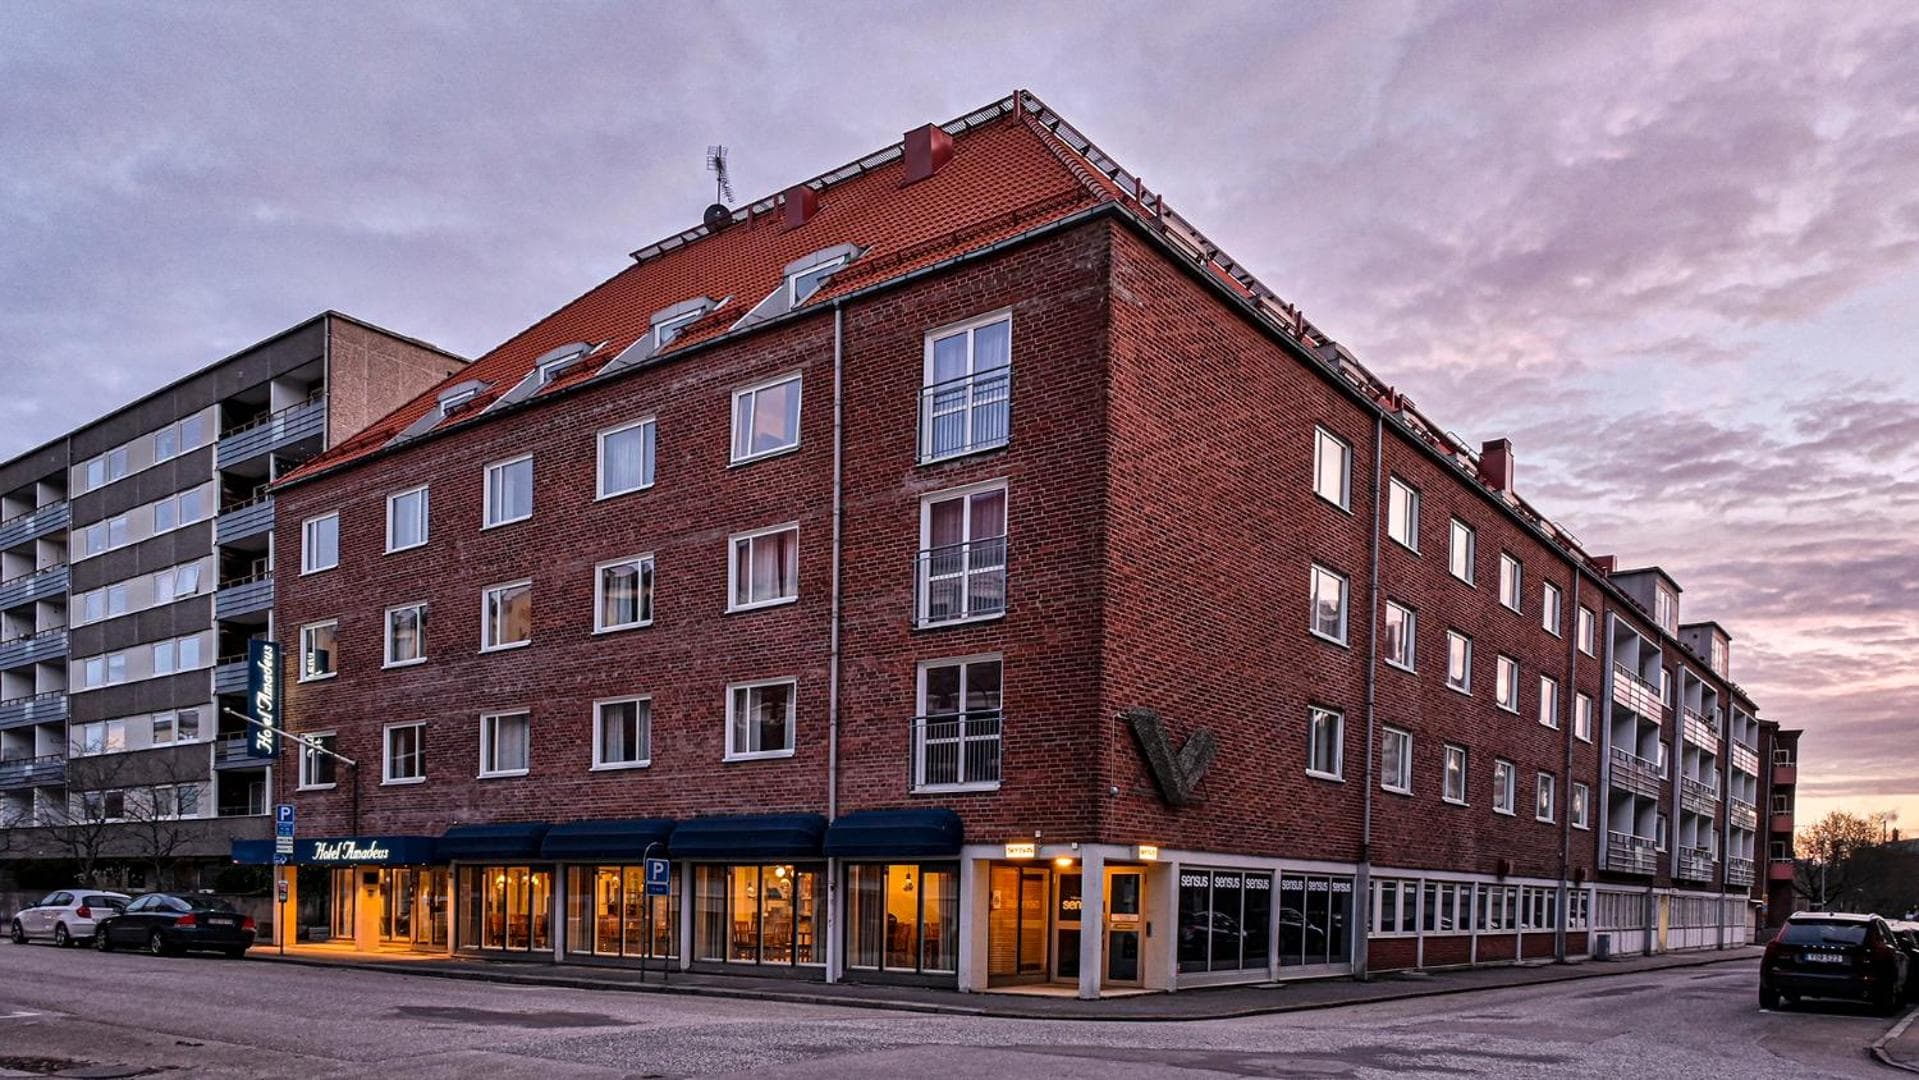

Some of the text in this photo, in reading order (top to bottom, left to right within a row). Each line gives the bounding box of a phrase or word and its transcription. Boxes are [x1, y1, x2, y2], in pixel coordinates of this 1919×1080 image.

[256, 645, 273, 755] Hoel Amadeus
[281, 807, 291, 821] P
[312, 840, 390, 860] Hotel Amadeus
[653, 862, 664, 880] P
[1181, 874, 1209, 887] sensus
[1214, 876, 1240, 889] sensus
[1245, 878, 1270, 890] sensus
[1281, 880, 1304, 890] sensus
[1062, 900, 1082, 911] sen
